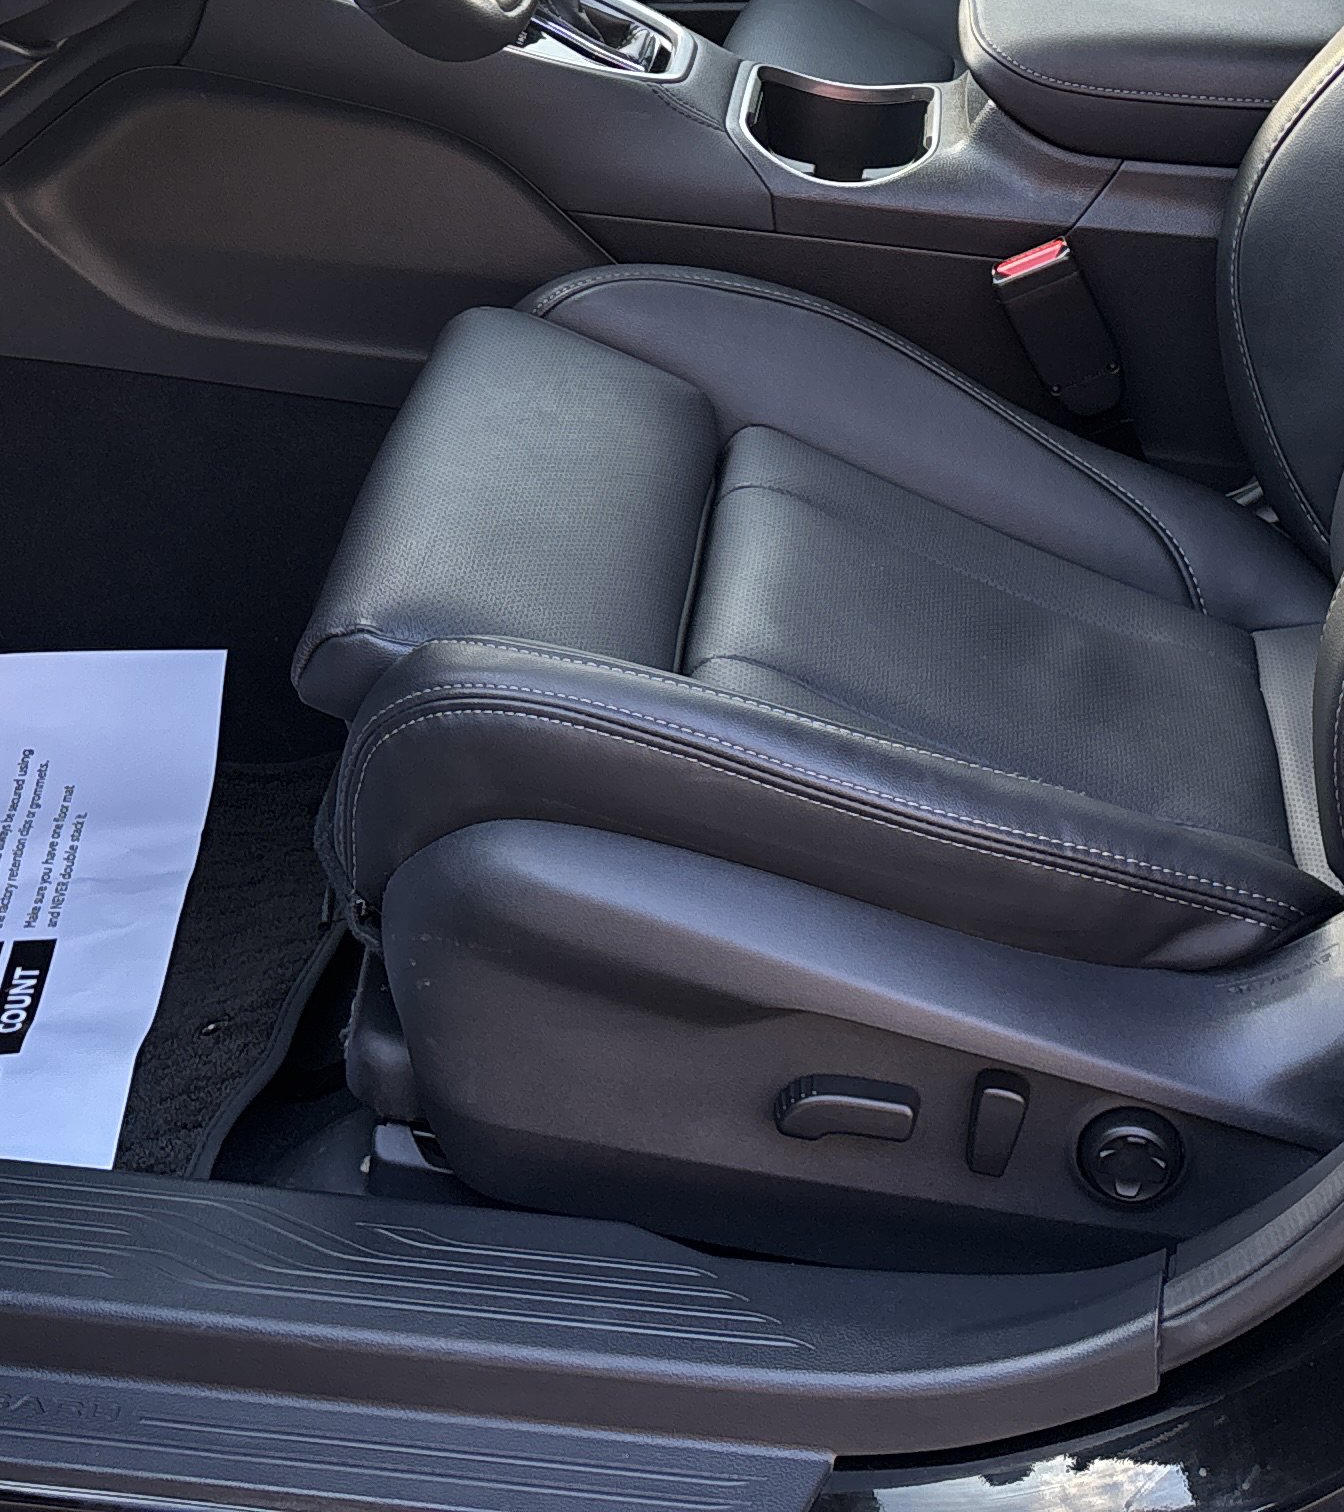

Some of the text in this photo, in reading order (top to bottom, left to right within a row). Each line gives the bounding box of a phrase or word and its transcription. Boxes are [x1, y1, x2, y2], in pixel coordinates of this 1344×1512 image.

[18, 748, 35, 777] using
[7, 837, 28, 882] retention
[41, 840, 59, 865] have
[59, 844, 79, 880] double
